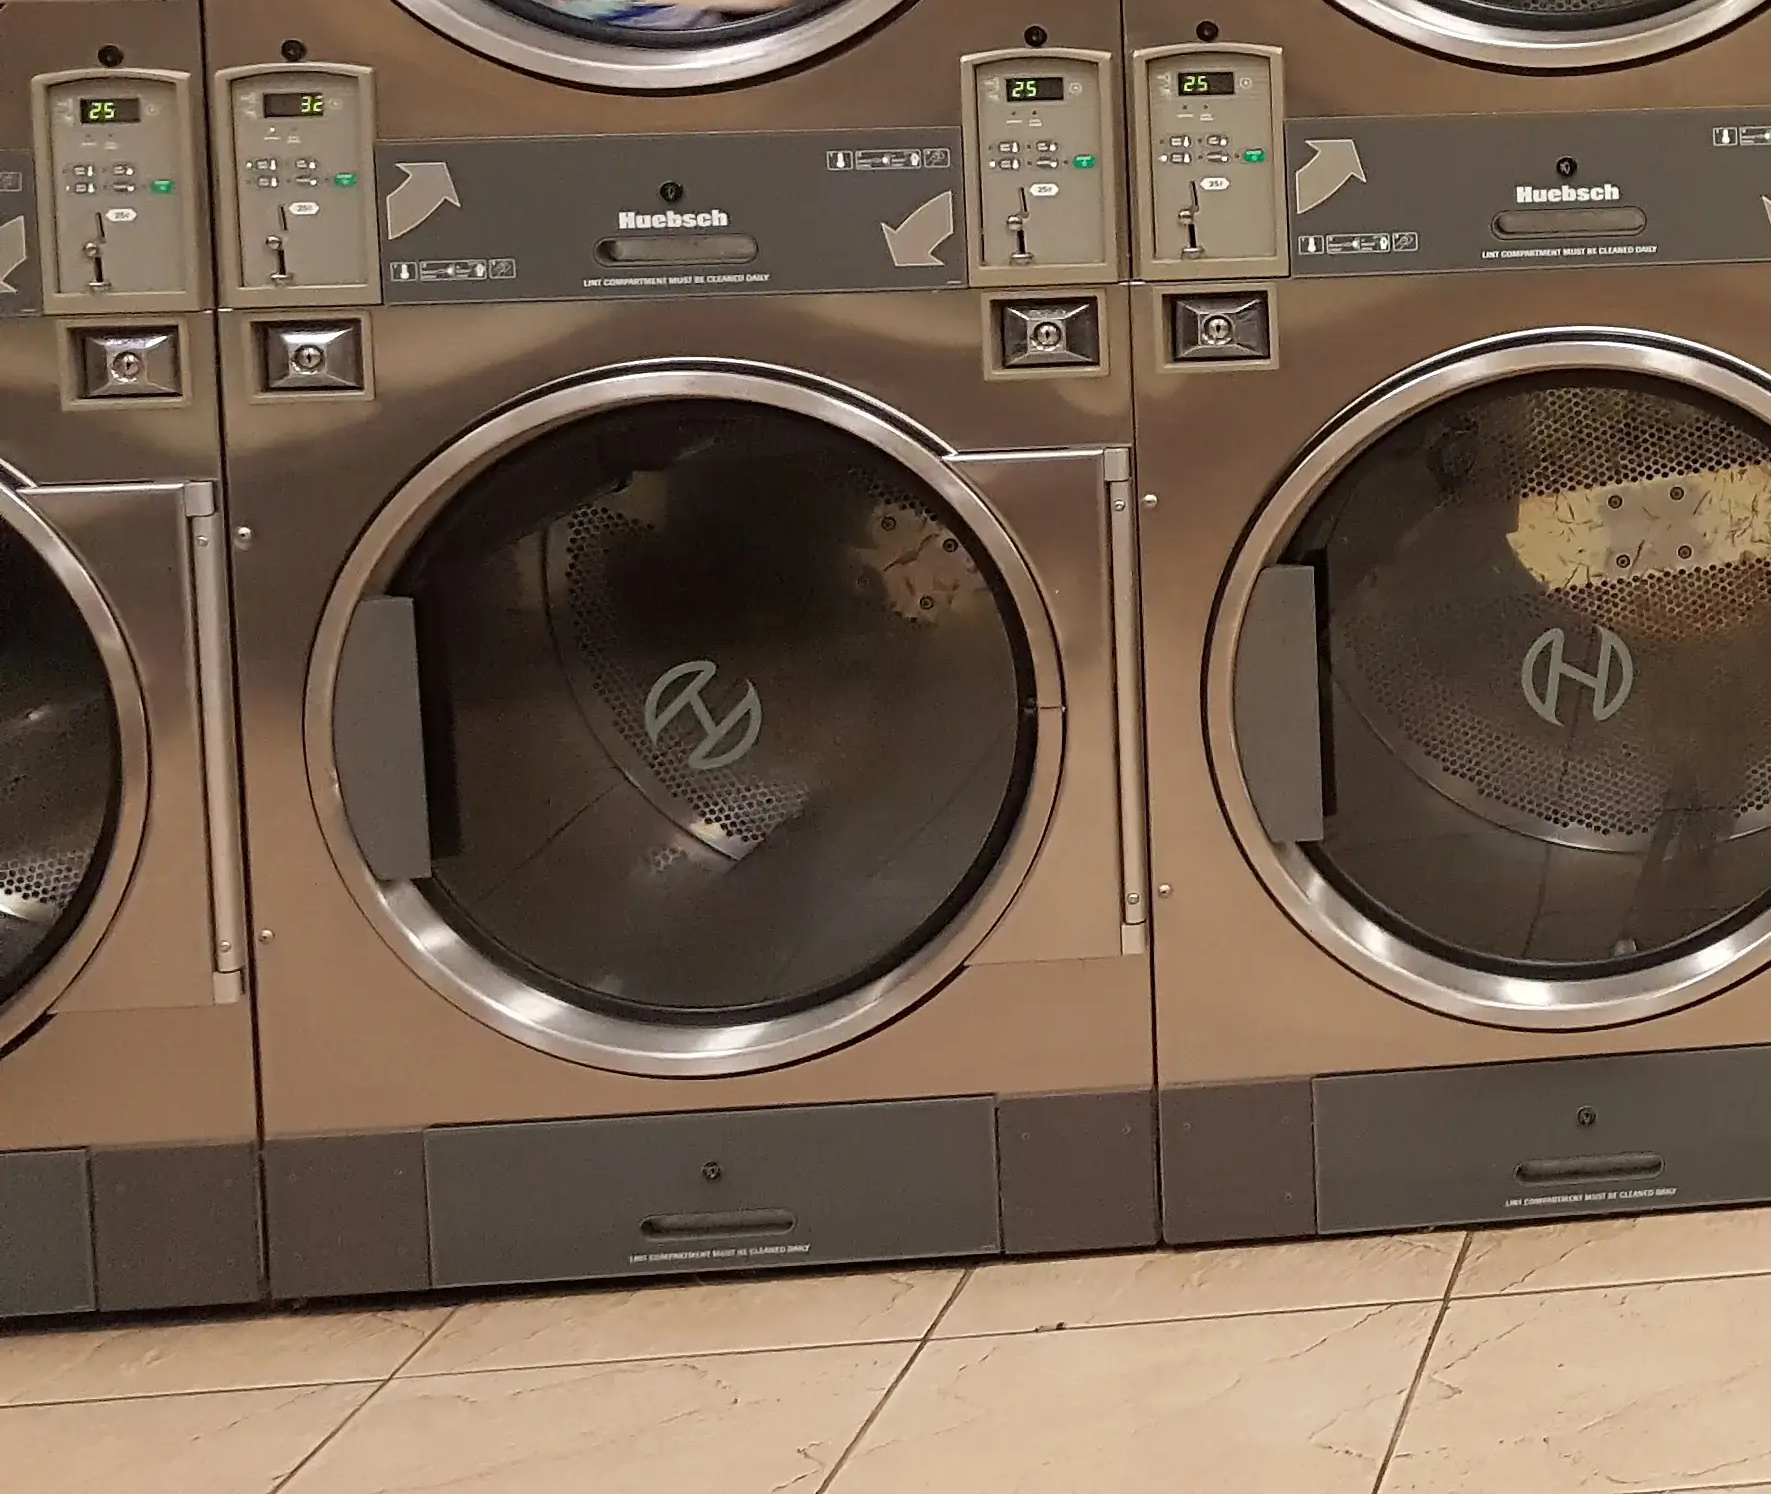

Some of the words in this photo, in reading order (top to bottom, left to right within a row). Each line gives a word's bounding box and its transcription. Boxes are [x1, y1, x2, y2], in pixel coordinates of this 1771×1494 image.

[1011, 81, 1037, 97] 25
[89, 102, 115, 119] 25
[301, 96, 325, 112] 32
[1516, 183, 1620, 203] Huebsch
[618, 209, 728, 229] Huebsch
